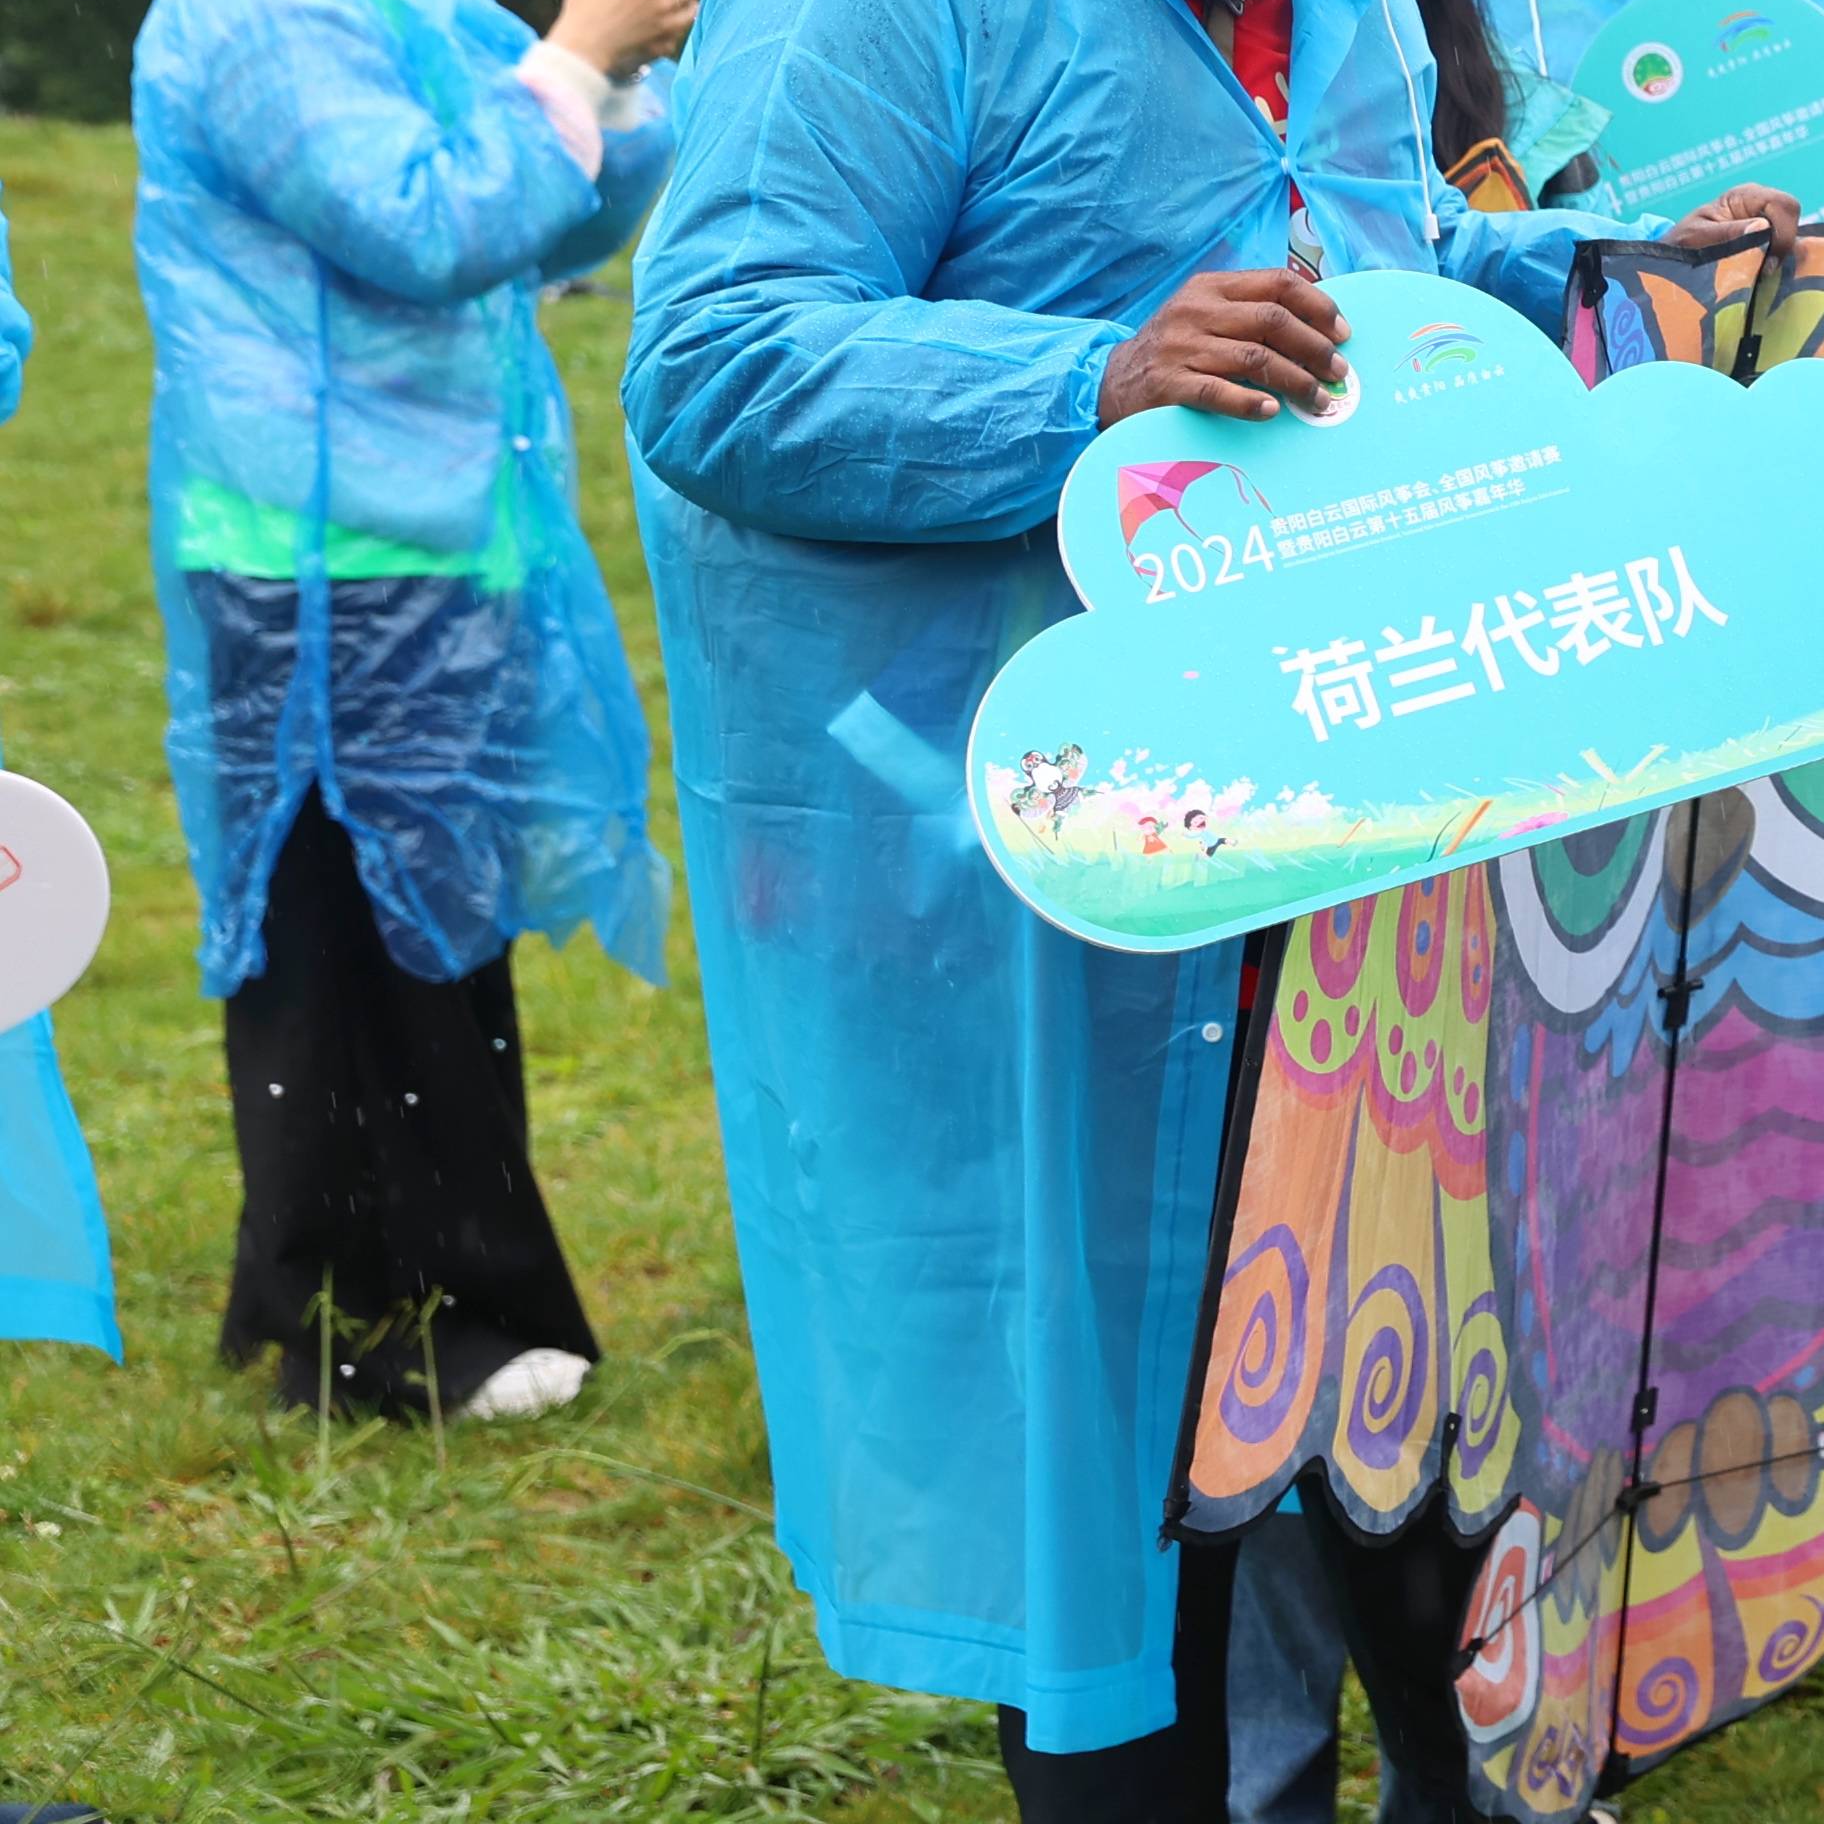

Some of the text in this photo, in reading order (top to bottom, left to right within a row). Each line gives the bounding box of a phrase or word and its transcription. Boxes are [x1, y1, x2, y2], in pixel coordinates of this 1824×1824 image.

[1269, 444, 1562, 537] 贵阳白云国际风筝会、全国风筝邀请赛
[1276, 478, 1526, 561] 暨贵阳白云第十五届风筝嘉年华
[1134, 523, 1276, 603] 2024
[1280, 544, 1728, 745] 荷兰代表队
